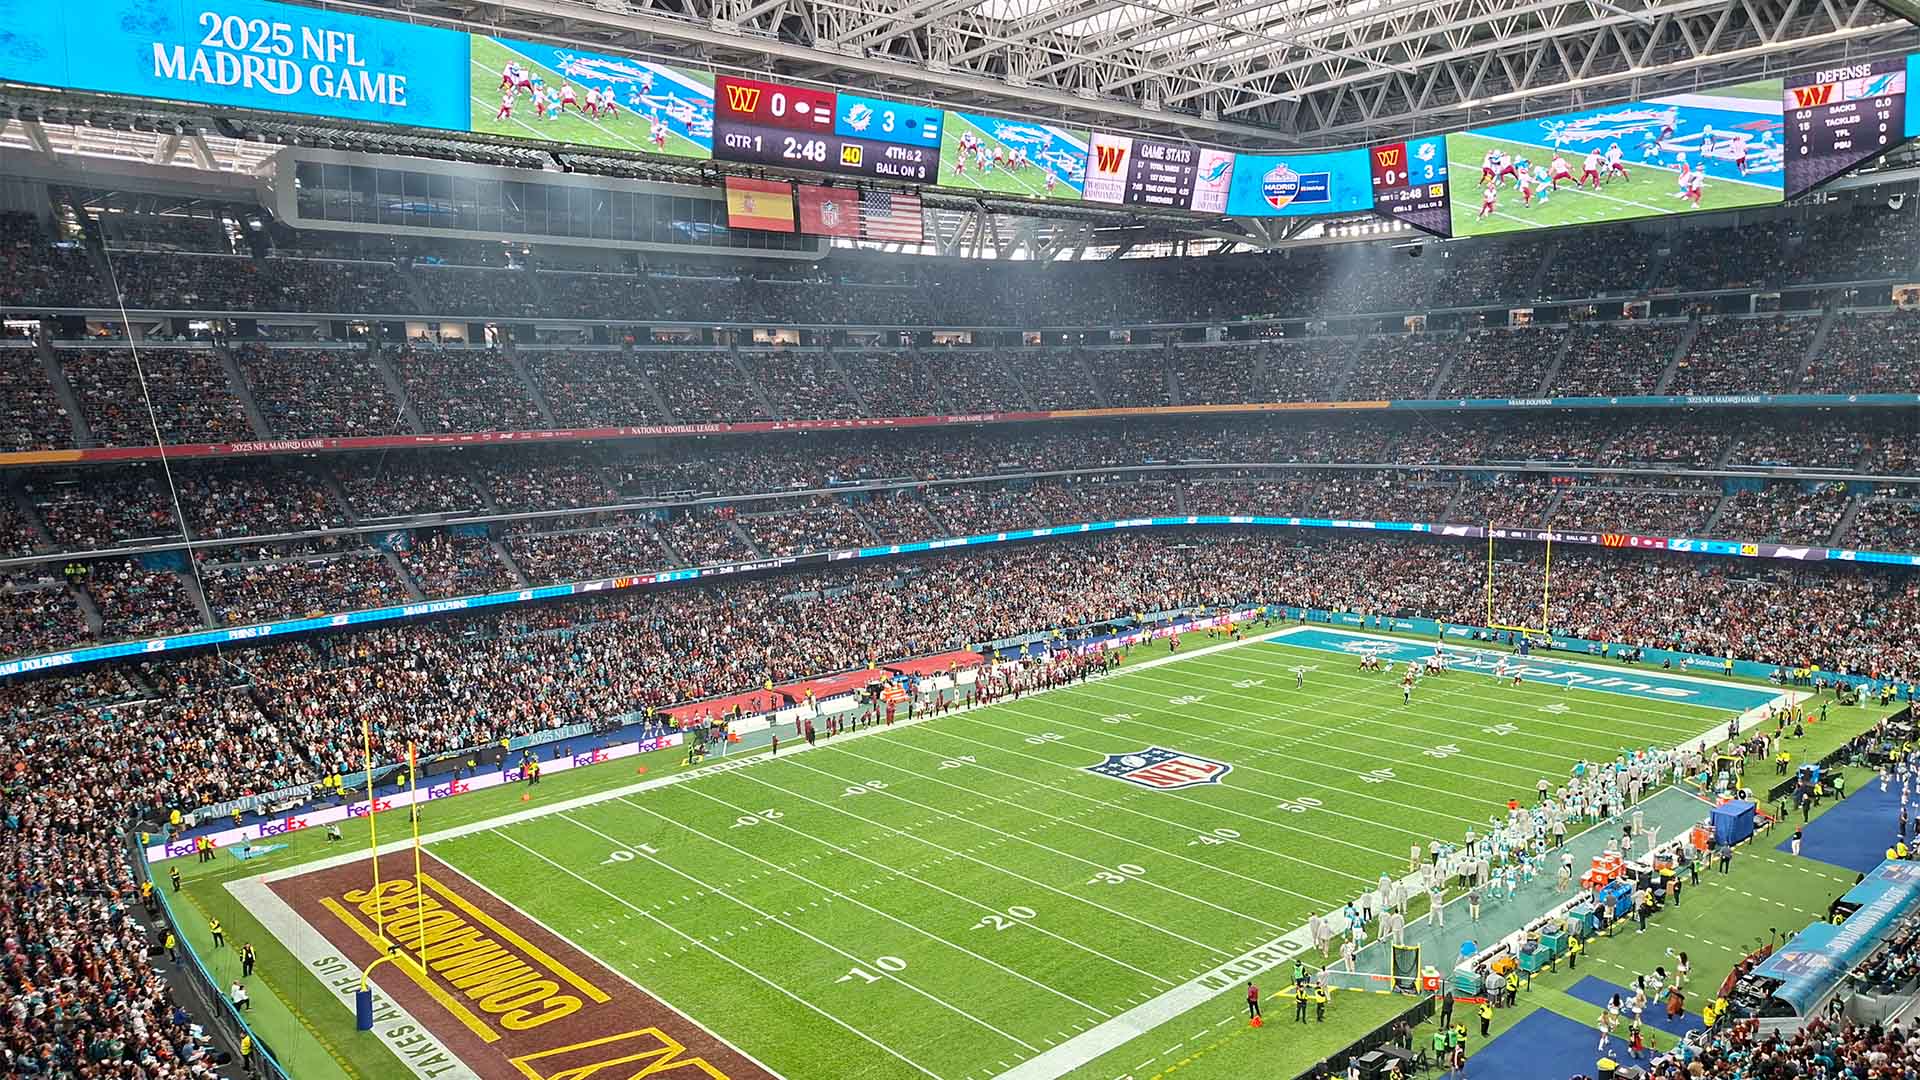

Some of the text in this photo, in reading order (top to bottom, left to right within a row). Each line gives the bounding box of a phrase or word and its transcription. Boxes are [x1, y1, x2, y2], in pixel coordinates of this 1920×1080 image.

[199, 11, 366, 67] 2025 NFL
[152, 42, 408, 106] MADRID GAME
[1816, 64, 1872, 84] DEFENSE
[770, 93, 786, 117] 0
[1829, 104, 1857, 114] SACKS
[1875, 98, 1891, 107] 0.0
[882, 111, 895, 132] 3
[1796, 110, 1812, 119] 0.0
[1825, 115, 1860, 127] TACKLES
[1877, 110, 1889, 120] 15
[1799, 121, 1810, 131] 15
[1835, 129, 1850, 138] TFL
[1879, 123, 1887, 132] 0
[725, 133, 762, 152] QTR 1
[1802, 134, 1807, 143] 1
[1879, 135, 1887, 145] 0
[783, 137, 826, 162] 2:48
[843, 145, 859, 164] 40
[1141, 145, 1191, 163] GAME STATS
[1800, 146, 1808, 155] 0
[876, 162, 926, 179] BALL ON 3
[1385, 170, 1396, 185] 0
[1424, 164, 1434, 179] 3
[1400, 188, 1422, 201] 2:48
[631, 424, 720, 435] NATIONAL FOOTBALL LEAGUE
[231, 440, 324, 452] 2025 NFL MADRID GAME
[1591, 535, 1598, 543] 3
[1630, 537, 1638, 546] 0
[259, 626, 271, 636] UP
[22, 654, 73, 671] DOLPHINS
[1101, 713, 1136, 724] 40
[638, 734, 672, 753] FedEx
[1025, 732, 1065, 745] 50
[573, 748, 608, 767] FedEx
[943, 755, 977, 770] 40
[675, 756, 762, 780] MADRID
[1125, 758, 1220, 787] NFL
[1358, 768, 1397, 783] 40
[428, 779, 470, 799] FedEx
[850, 780, 889, 796] 30
[211, 798, 252, 818] MIAMI
[347, 798, 392, 818] FedEx
[1276, 797, 1323, 813] 50
[258, 816, 308, 836] FedEx
[736, 808, 785, 828] 20
[1199, 828, 1241, 846] 40
[610, 842, 661, 863] 10
[1095, 863, 1147, 885] 30
[981, 905, 1037, 931] 20
[343, 879, 583, 1031] COMMANDERS
[312, 956, 348, 976] US
[848, 956, 907, 985] 10
[1196, 939, 1304, 991] MADRID
[386, 1024, 457, 1079] TAKES
